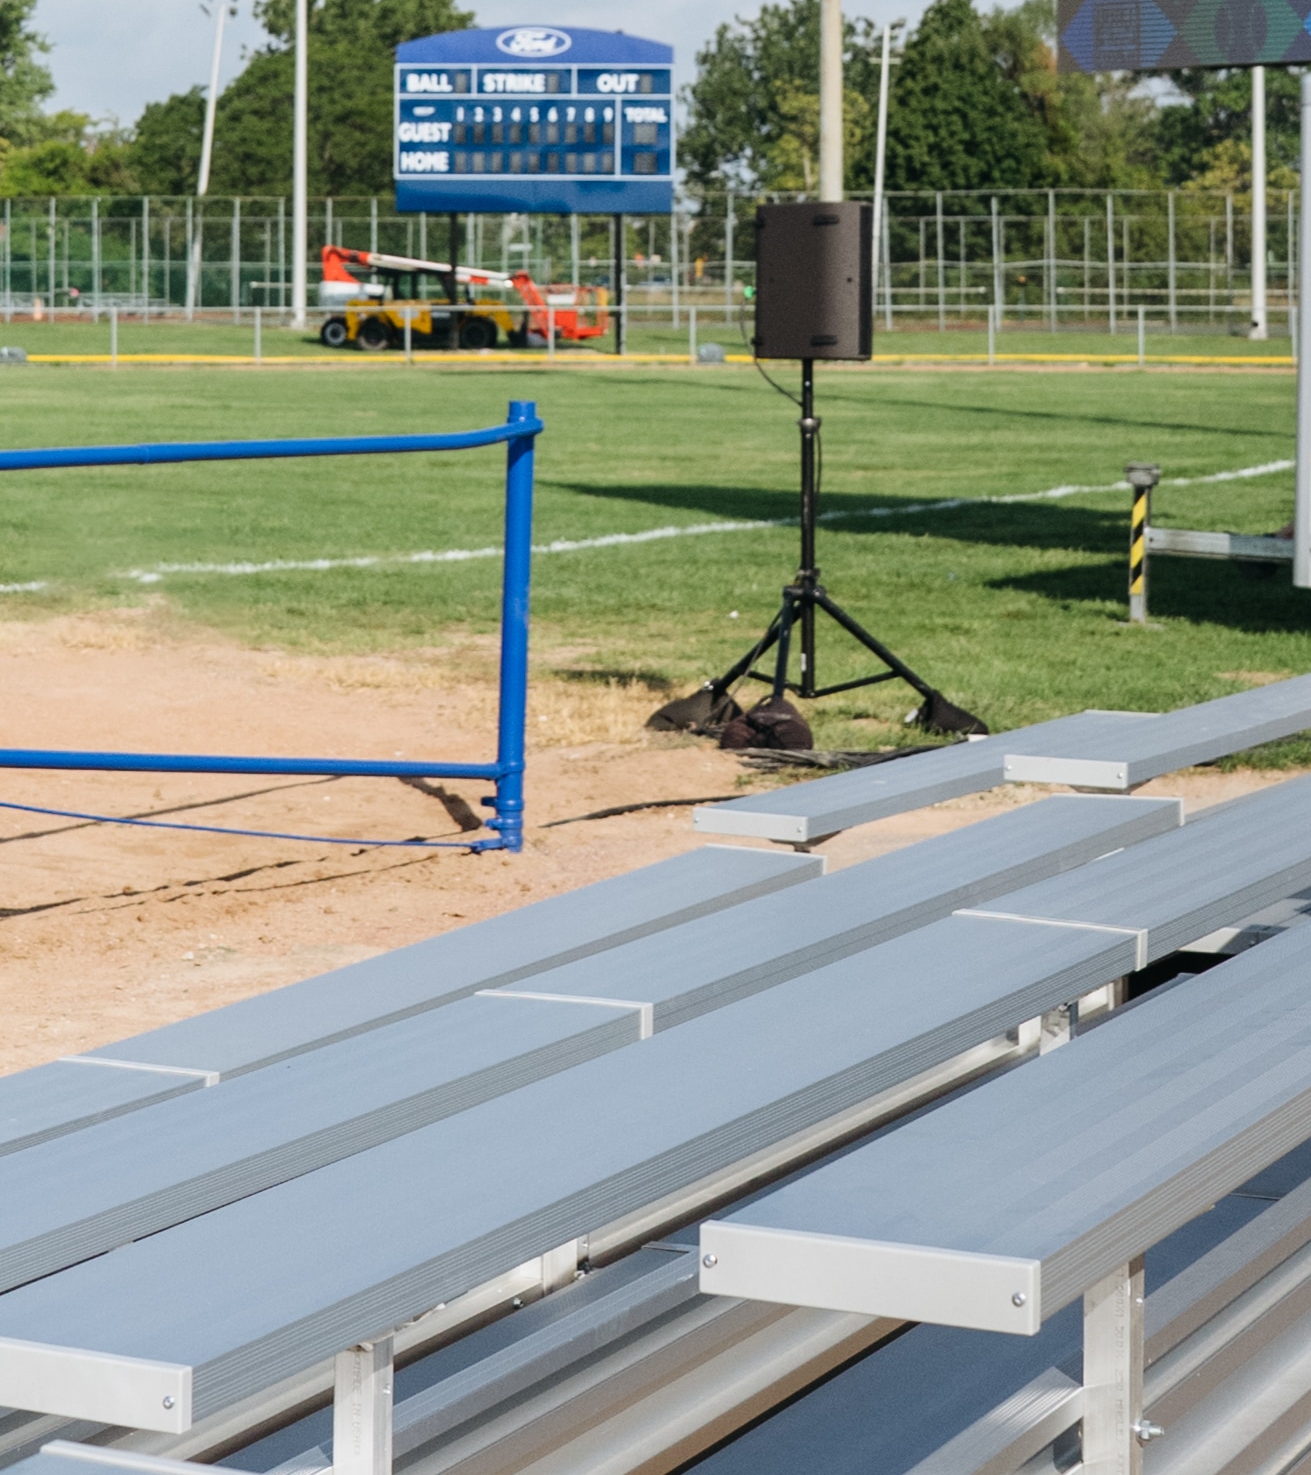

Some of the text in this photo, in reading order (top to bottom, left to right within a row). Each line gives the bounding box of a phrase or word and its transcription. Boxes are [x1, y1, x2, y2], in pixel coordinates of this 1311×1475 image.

[405, 73, 640, 93] BALL STRIKE OUT
[456, 106, 465, 123] 1
[473, 106, 485, 123] 2
[492, 106, 503, 123] 3
[510, 106, 522, 123] 4
[547, 106, 558, 123] 6
[602, 106, 614, 123] 9
[624, 106, 669, 124] TOTAL
[398, 122, 453, 143] GUEST
[399, 151, 450, 172] HOME
